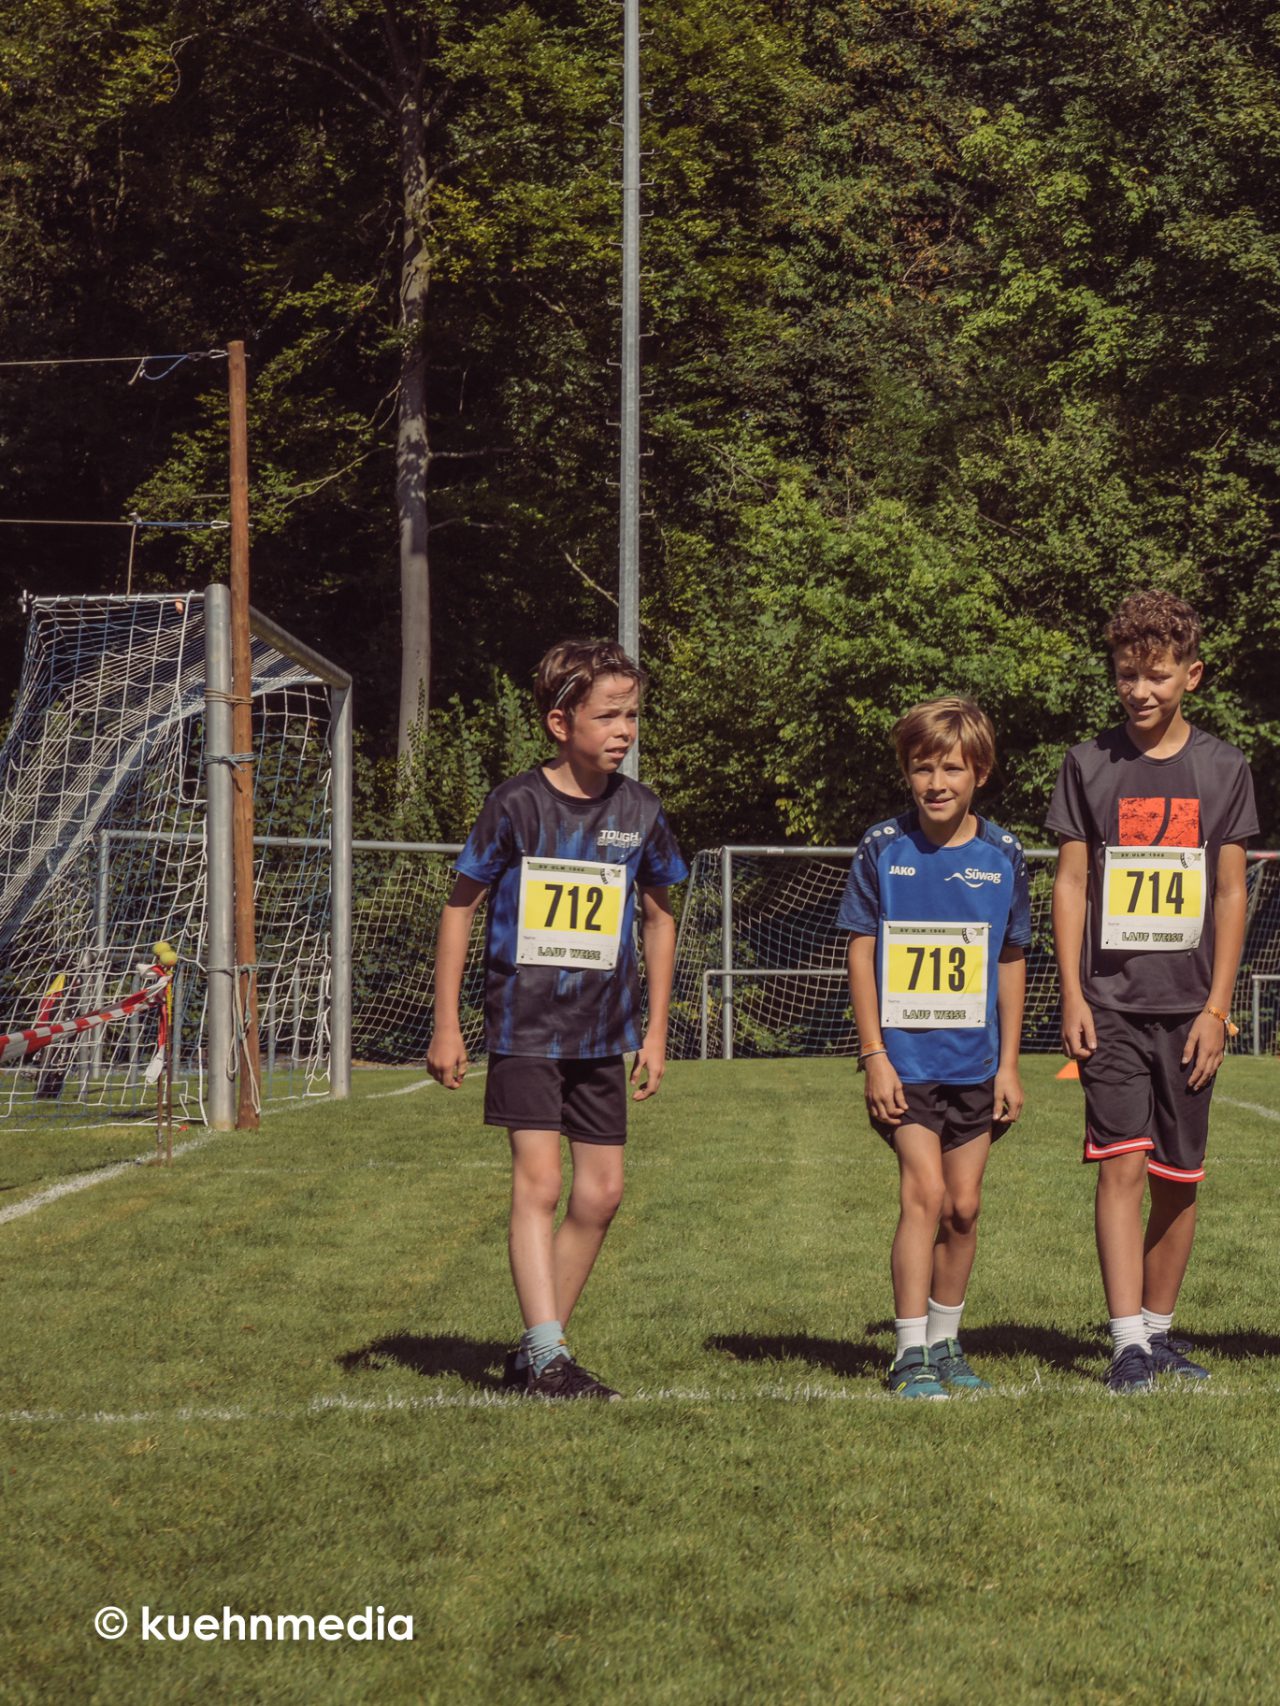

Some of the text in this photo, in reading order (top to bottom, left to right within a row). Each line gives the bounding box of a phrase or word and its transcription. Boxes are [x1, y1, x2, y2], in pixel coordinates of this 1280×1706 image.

[600, 829, 640, 842] TOUGH
[888, 865, 916, 877] JAKO
[964, 867, 1002, 884] Süwag
[1126, 870, 1184, 915] 714
[544, 883, 604, 932] 712
[1121, 931, 1184, 942] LAUF WEISE
[538, 946, 601, 961] LAUF WEISE
[907, 946, 966, 992] 713
[902, 1008, 967, 1020] LAUF WEISE
